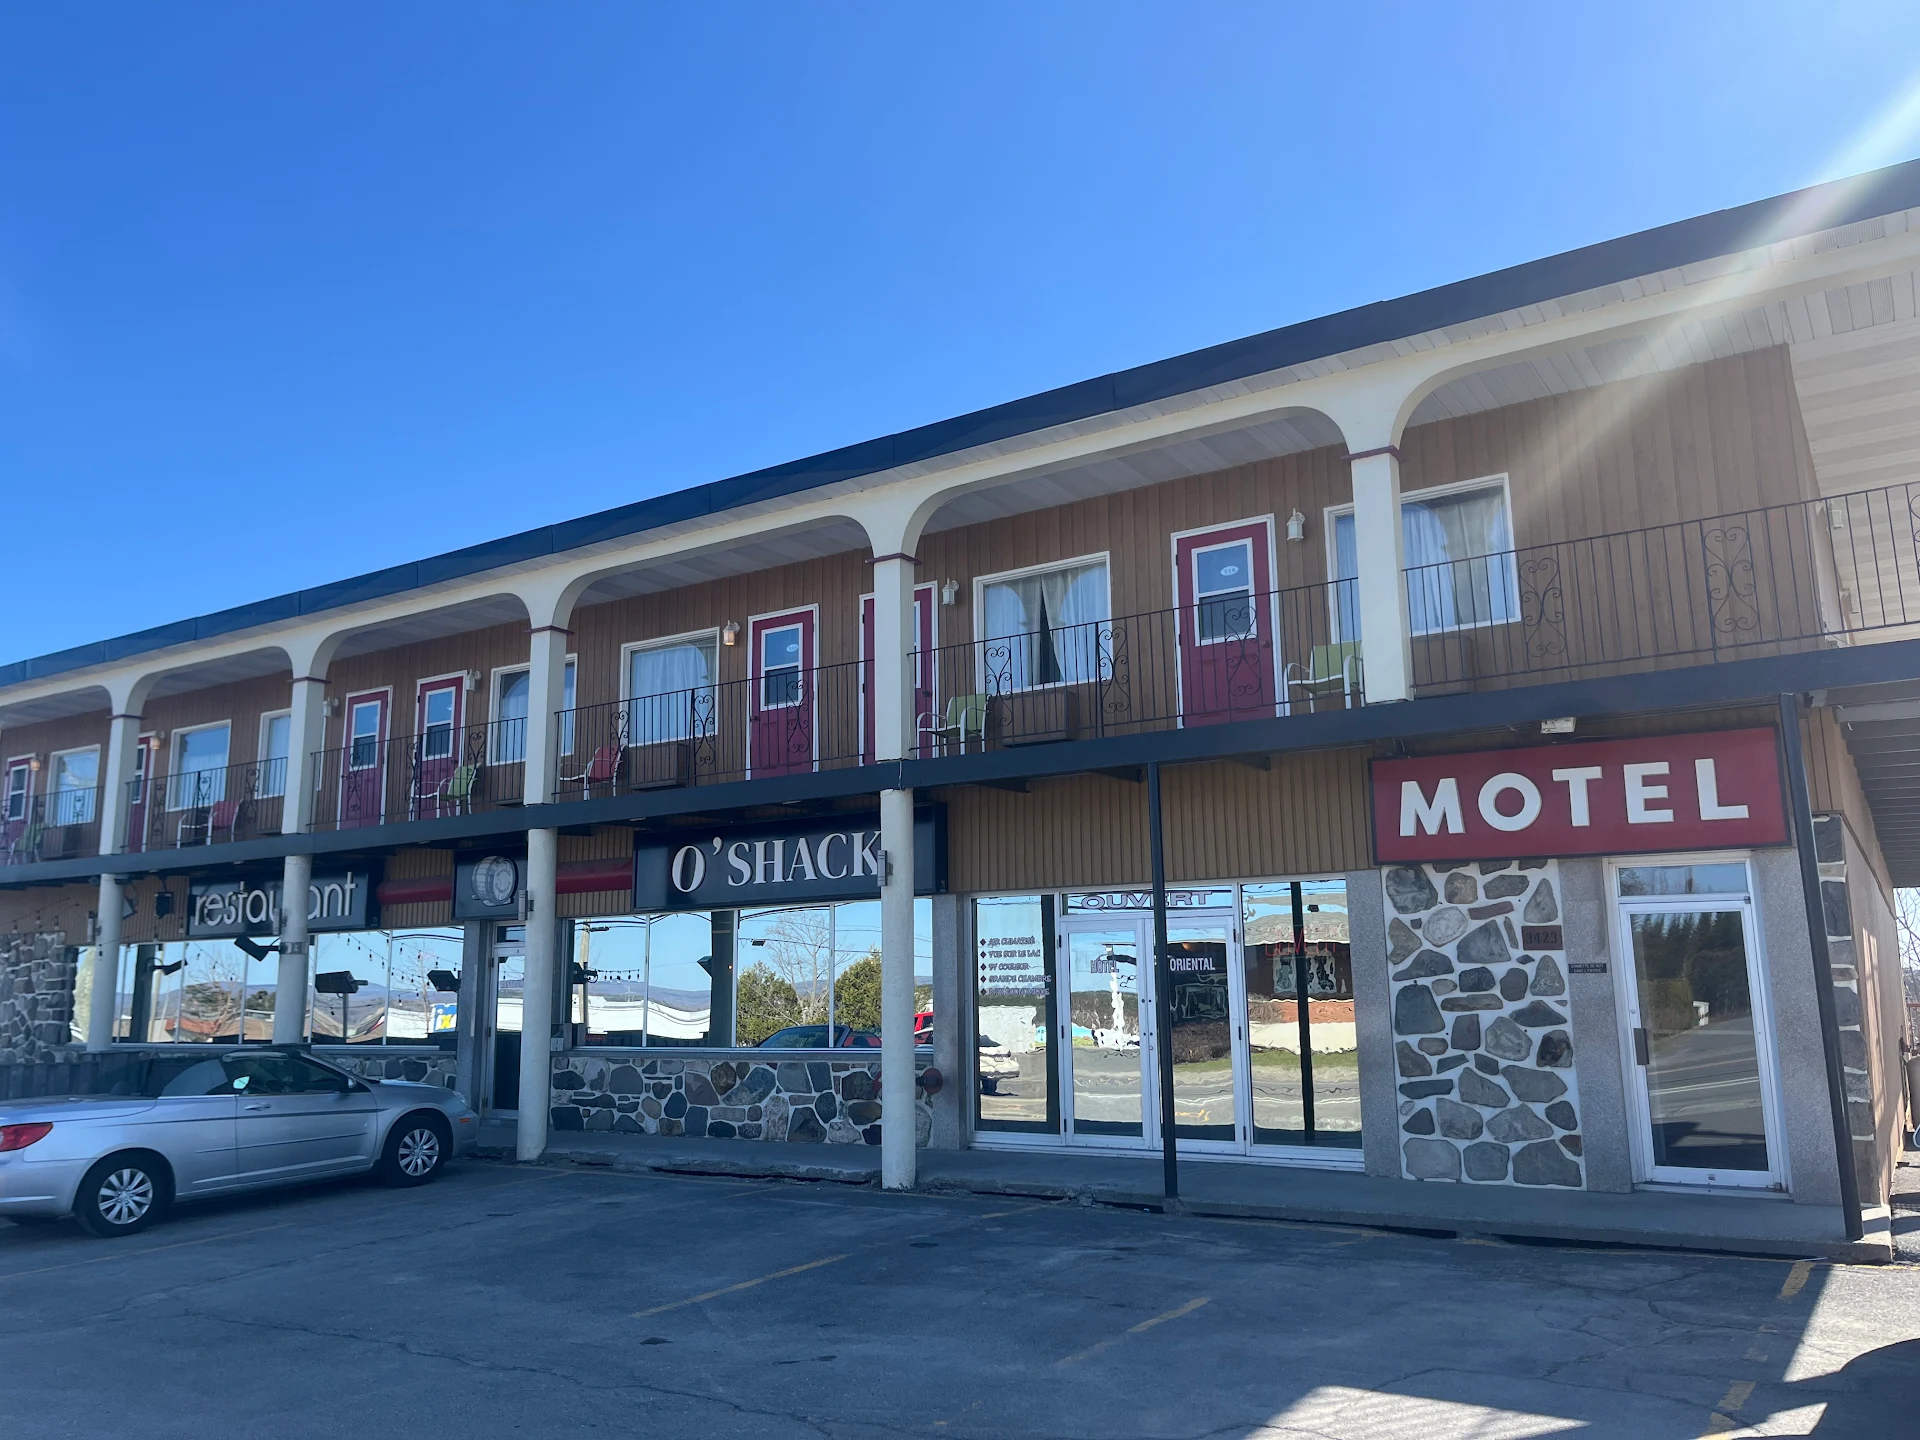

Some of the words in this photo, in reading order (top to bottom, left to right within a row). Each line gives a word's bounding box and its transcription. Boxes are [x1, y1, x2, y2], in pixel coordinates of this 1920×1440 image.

[1399, 758, 1750, 837] MOTEL
[671, 829, 882, 893] O'SHACK
[194, 871, 356, 926] restaant
[988, 950, 1002, 958] VUE
[1003, 950, 1017, 958] SUR
[1018, 950, 1026, 958] LE
[1525, 931, 1558, 945] 3423
[1169, 957, 1216, 972] ORIENTAL
